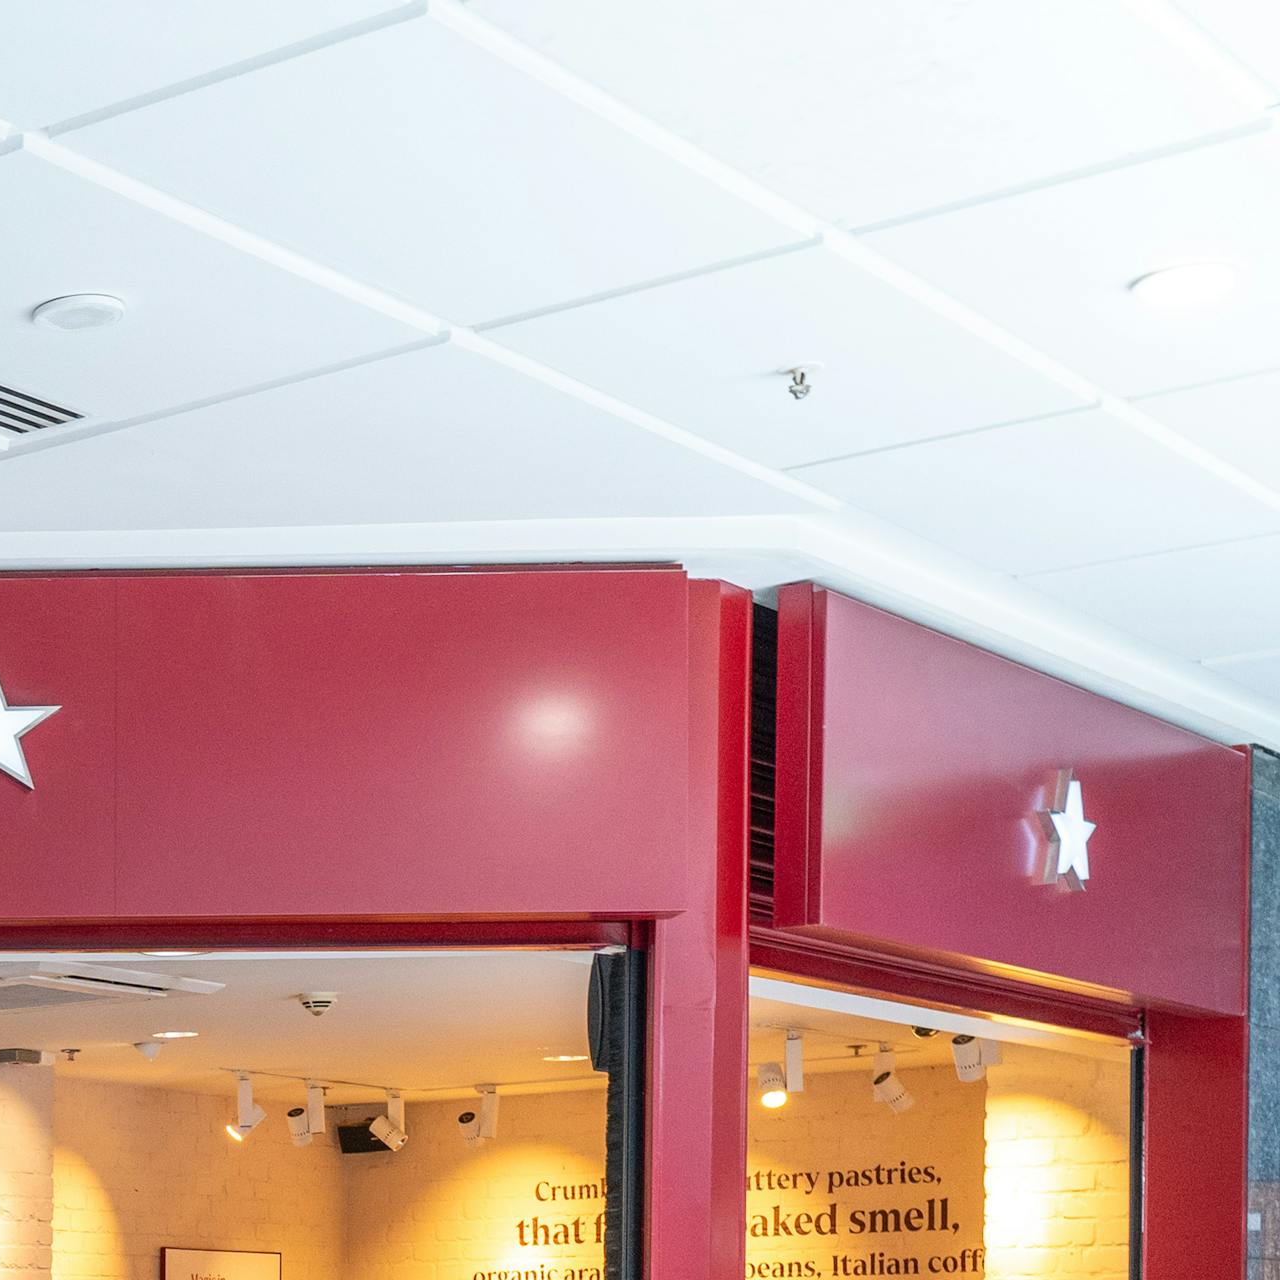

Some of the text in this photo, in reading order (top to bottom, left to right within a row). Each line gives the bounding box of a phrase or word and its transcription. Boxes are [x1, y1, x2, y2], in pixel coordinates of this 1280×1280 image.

[828, 1161, 942, 1194] pastries,
[516, 1216, 586, 1246] that
[848, 1198, 960, 1235] smell,
[832, 1252, 920, 1276] Italian
